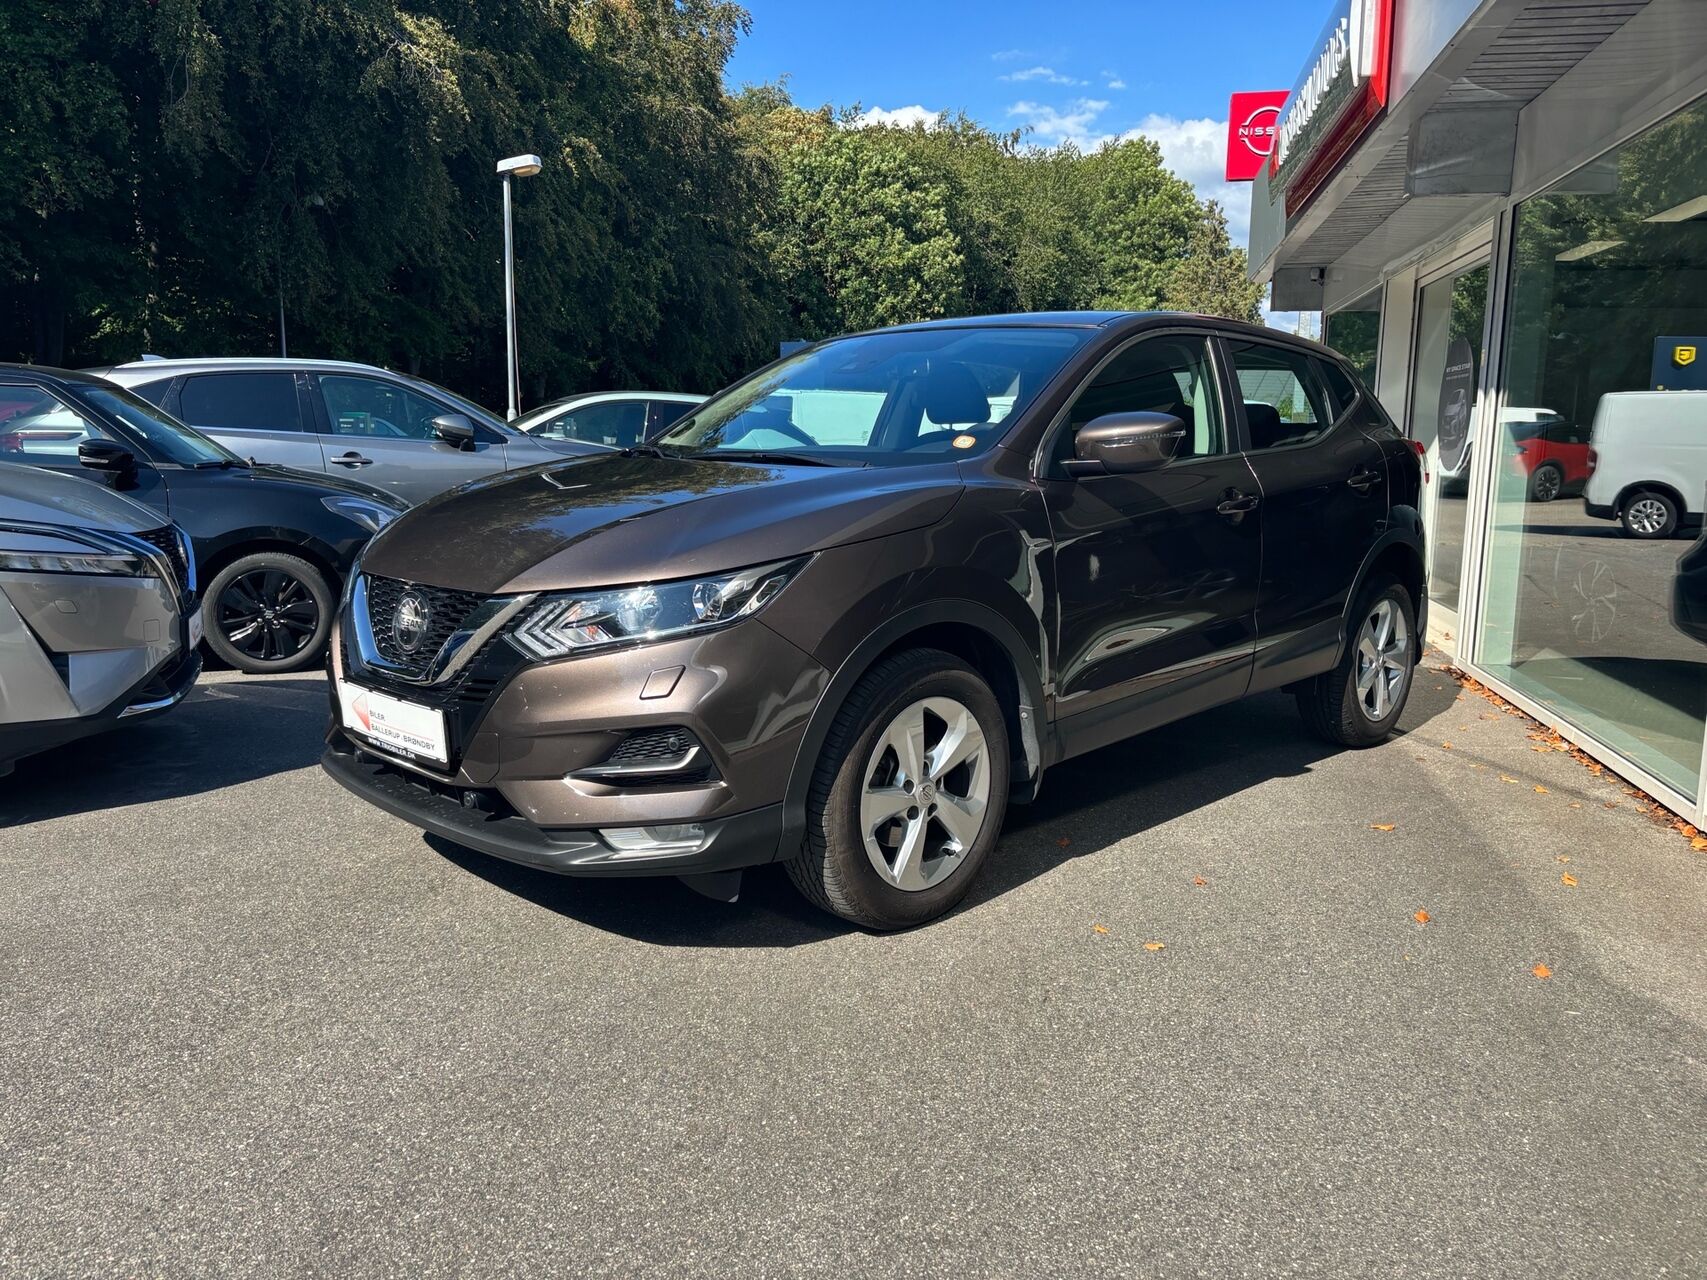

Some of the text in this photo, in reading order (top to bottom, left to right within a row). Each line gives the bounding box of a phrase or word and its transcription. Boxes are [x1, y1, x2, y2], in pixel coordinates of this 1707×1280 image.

[1239, 126, 1275, 136] NISS
[371, 723, 435, 750] BALLERUP BRØNDBY
